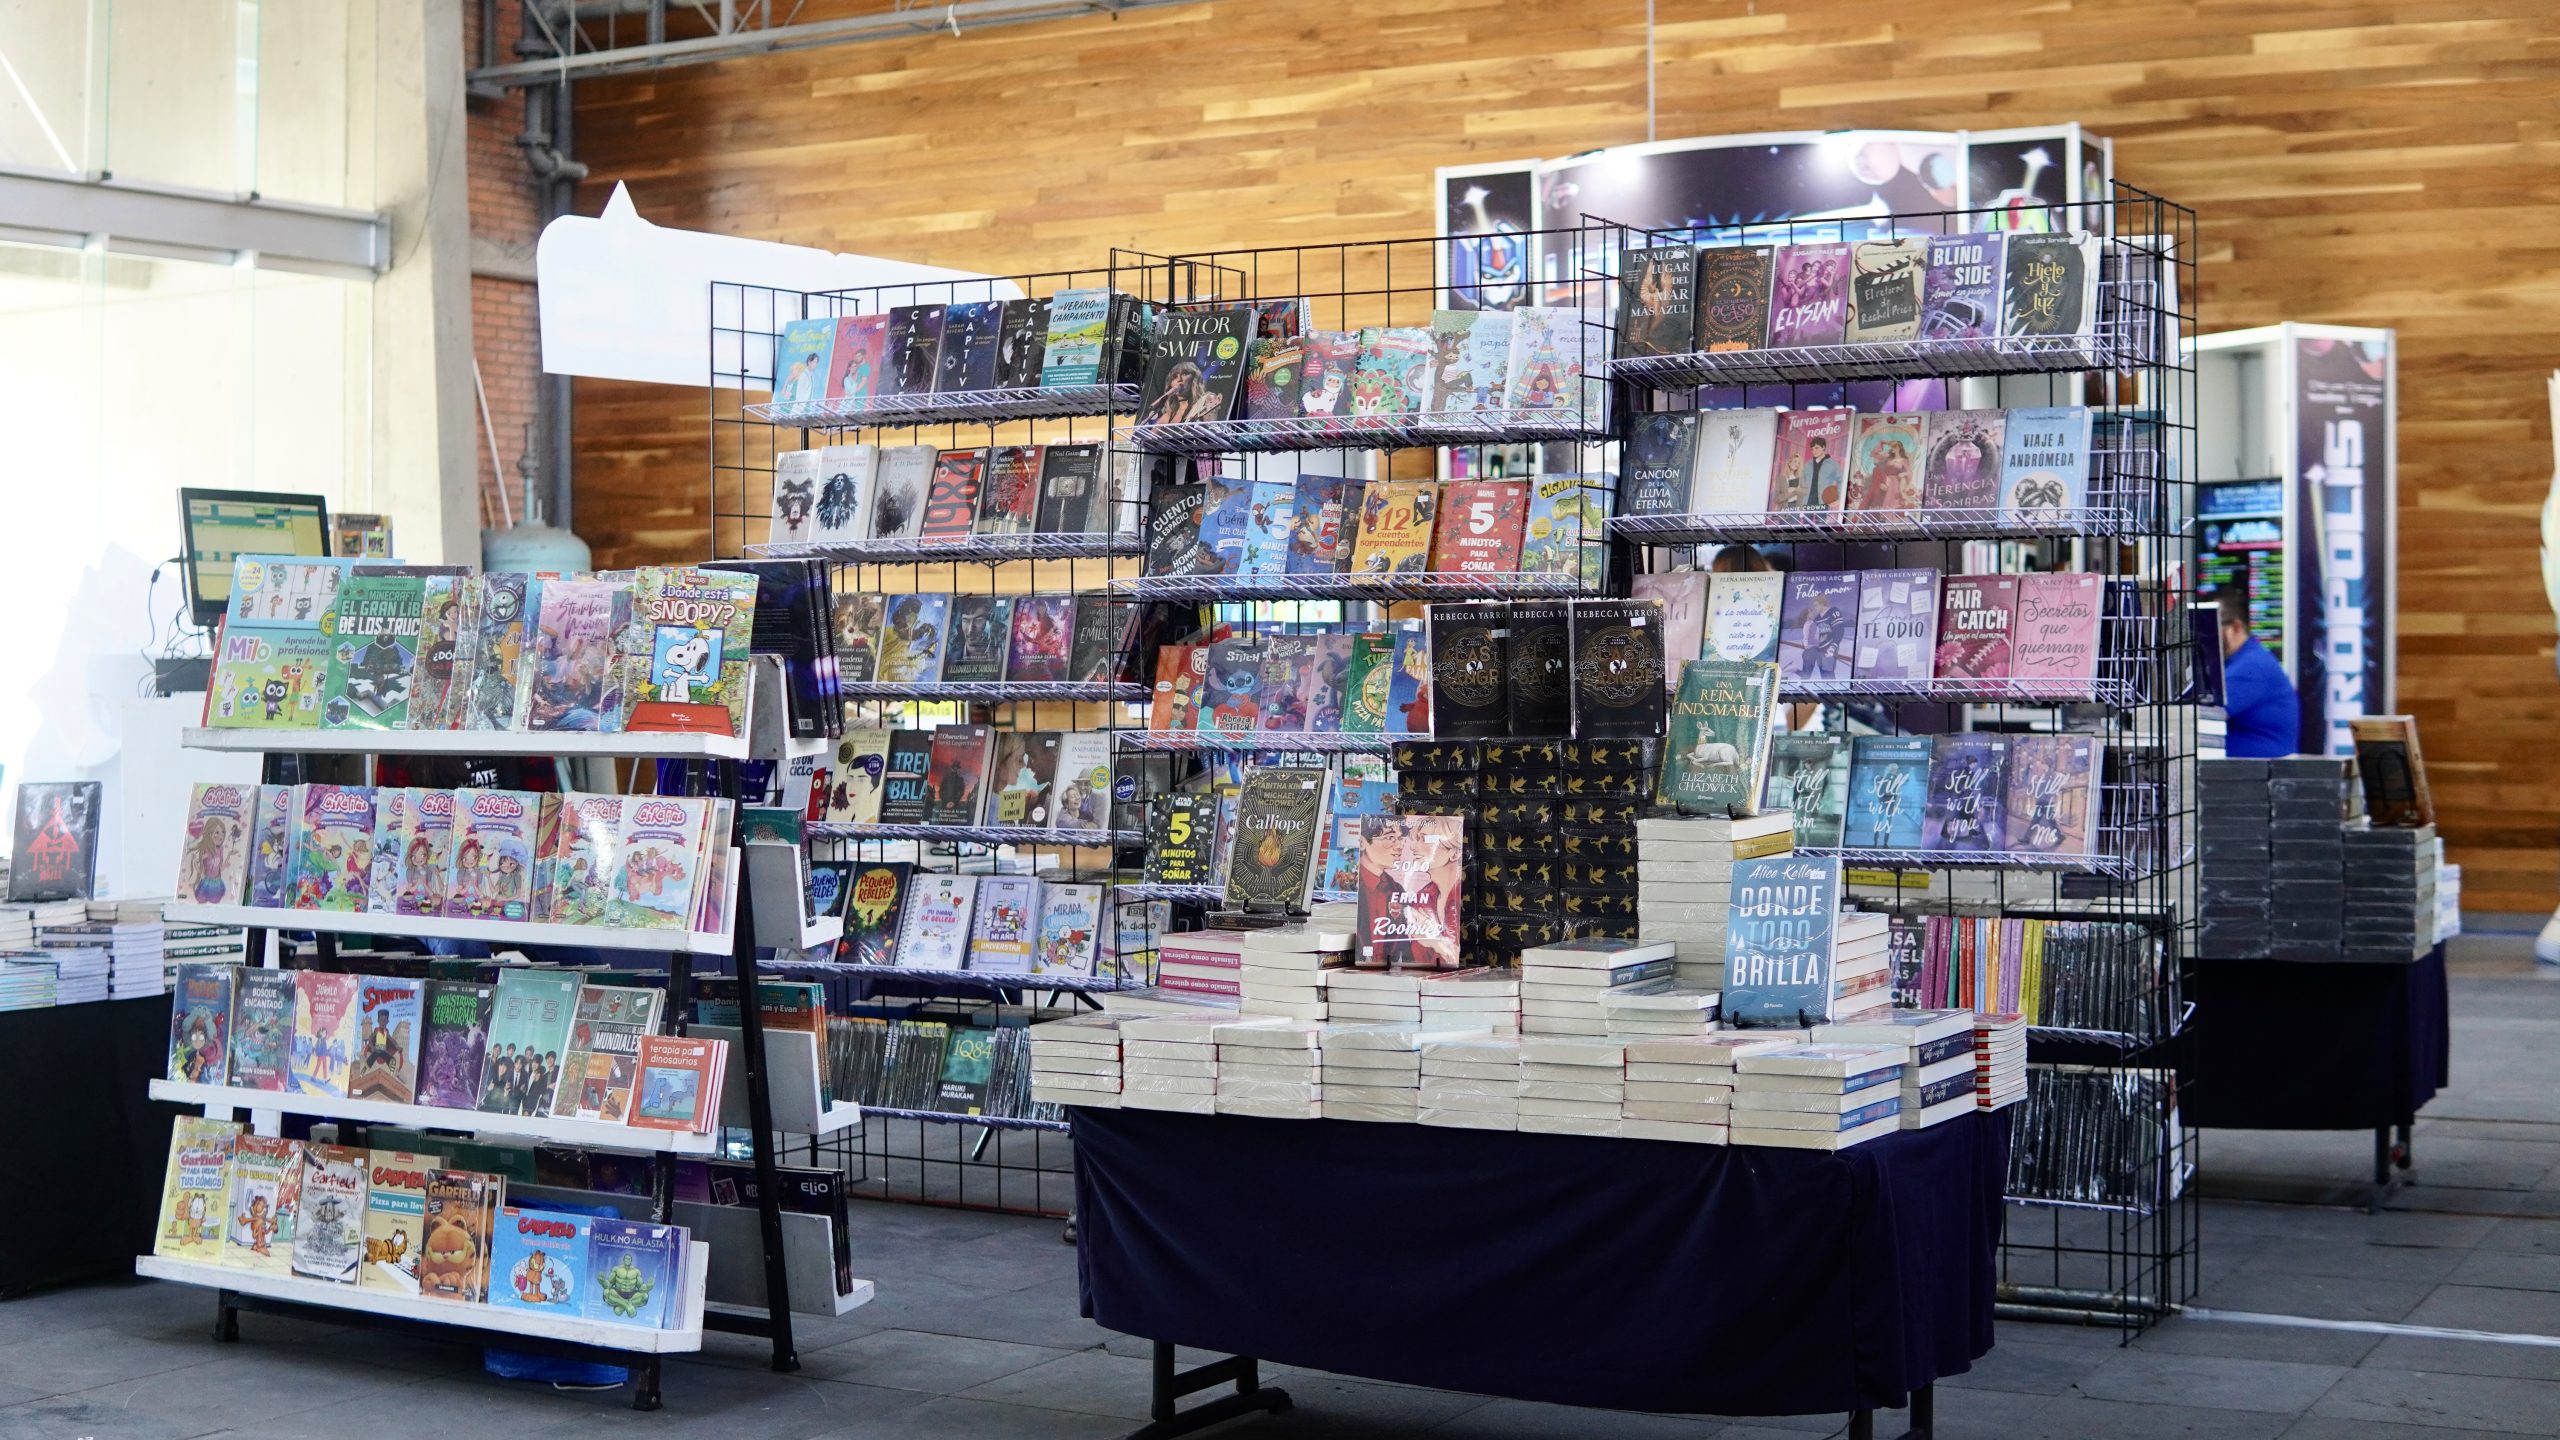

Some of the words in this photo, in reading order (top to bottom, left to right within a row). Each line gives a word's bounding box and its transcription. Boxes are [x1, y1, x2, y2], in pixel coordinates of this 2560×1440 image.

[1633, 253, 1647, 263] EN
[1933, 246, 1982, 266] BLIND
[1652, 263, 1690, 274] LUGAR
[1954, 266, 1991, 285] SIDE
[2024, 262, 2065, 284] Hielo
[1672, 276, 1689, 284] DEL
[1655, 289, 1688, 300] MAR
[1864, 288, 1873, 300] El
[1875, 285, 1905, 297] retorno
[1930, 289, 1954, 301] Amor
[1957, 290, 1966, 298] en
[1968, 288, 1992, 299] juego
[2042, 283, 2049, 295] y
[1064, 300, 1094, 310] VERANO
[1881, 297, 1890, 307] de
[2034, 293, 2055, 316] luz
[1053, 311, 1104, 322] CAMPAMENTO
[1631, 305, 1656, 317] MÁS
[1660, 305, 1688, 314] AZUL
[1776, 298, 1839, 332] ELYSIAN
[1862, 310, 1890, 324] Rachel
[1891, 304, 1912, 316] Price
[1161, 316, 1230, 336] TAYLOR
[1156, 340, 1216, 358] SWIFT
[1789, 416, 1819, 431] Turno
[1807, 424, 1841, 437] noche
[2023, 433, 2054, 448] VIAJE
[2058, 433, 2064, 446] A
[2010, 452, 2074, 467] ANDRÓMEDA
[1635, 469, 1680, 480] CANCIÓN
[1477, 490, 1496, 498] MARVEL
[1640, 489, 1671, 498] LLUVIA
[1926, 478, 1996, 497] HERENCIA
[1636, 499, 1672, 509] ETERNA
[1936, 494, 1995, 509] SOMBRAS
[1153, 493, 1203, 532] CUENTOS
[1382, 508, 1411, 531] 12
[1470, 503, 1495, 534] 5
[1152, 536, 1163, 549] DEL
[1162, 512, 1189, 537] ESPACIO
[1360, 539, 1424, 548] sorprendentes
[1460, 538, 1501, 547] MINUTOS
[1461, 558, 1495, 571] SOÑAR
[661, 586, 700, 598] ¿Dónde
[705, 588, 729, 600] está
[1796, 583, 1820, 600] Falso
[1824, 585, 1852, 596] amor
[1946, 590, 1982, 609] FAIR
[342, 601, 357, 615] EL
[360, 601, 397, 616] GRAN
[650, 601, 735, 625] SNOOPY?
[1434, 611, 1474, 620] REBECCA
[1514, 610, 1553, 618] REBECCA
[1623, 609, 1658, 617] YARROS
[2021, 598, 2089, 623] Secretos
[339, 616, 355, 634] DE
[358, 617, 382, 634] LOS
[1957, 610, 2007, 630] CATCH
[1864, 623, 1880, 639] TE
[1887, 620, 1924, 638] ODIO
[1943, 632, 1954, 641] Un
[2040, 624, 2069, 640] que
[285, 637, 311, 645] Aprende
[227, 635, 271, 664] Milo
[278, 647, 330, 656] profesiones
[1226, 651, 1260, 663] STITCH
[2018, 643, 2087, 661] queman
[1701, 690, 1744, 702] REINA
[1352, 700, 1370, 721] PIZZA
[1678, 703, 1761, 717] INDOMABLE
[790, 767, 813, 776] CICLO
[1681, 773, 1739, 782] ELIZABETH
[1679, 782, 1737, 793] CHADWICK
[1787, 768, 1829, 793] Still
[1868, 773, 1909, 796] Still
[1945, 769, 1987, 792] Still
[2026, 772, 2070, 796] Still
[1003, 793, 1021, 802] VIOLET
[1004, 808, 1020, 817] FINCH
[1788, 799, 1824, 818] with
[1869, 801, 1905, 818] with
[1947, 796, 1983, 818] with
[2026, 803, 2063, 820] with
[1170, 812, 1191, 844] 5
[1246, 814, 1304, 834] Calliope
[1874, 818, 1893, 833] us
[1948, 817, 1979, 843] you
[1161, 849, 1196, 858] MINUTOS
[1162, 867, 1191, 880] SOÑAR
[1392, 861, 1430, 872] SOLO
[1748, 864, 1777, 880] Alice
[859, 872, 895, 889] PEQUEÑAS
[857, 887, 892, 903] REBELDES
[1391, 892, 1429, 904] ERAN
[1740, 886, 1823, 917] DONDE
[1053, 903, 1082, 916] MIRADA
[1373, 917, 1443, 937] Roomies
[1001, 930, 1015, 942] AÑO
[1747, 920, 1811, 951] TODO
[980, 942, 1021, 954] UNIVERSTAR
[1164, 952, 1189, 960] quieras
[1211, 956, 1238, 965] Llámalo
[1732, 953, 1819, 987] BRILLA
[1164, 979, 1189, 987] quieras
[1211, 981, 1238, 992] Llámalo
[252, 987, 277, 998] BOSQUE
[244, 1000, 283, 1009] ENCANTADO
[505, 997, 560, 1022] BTS
[595, 1032, 640, 1052] MUNDIALES
[650, 1045, 679, 1056] terapia
[953, 1040, 992, 1060] 1Q84
[651, 1056, 697, 1065] dinosaurios
[941, 1091, 974, 1100] MURAKAMI
[943, 1084, 966, 1092] HARUKI
[312, 1170, 356, 1189] Garfield
[371, 1197, 391, 1206] Pizza
[393, 1199, 408, 1208] para
[594, 1232, 616, 1244] HULK
[617, 1234, 630, 1244] NO
[631, 1236, 664, 1248] APLASTA
